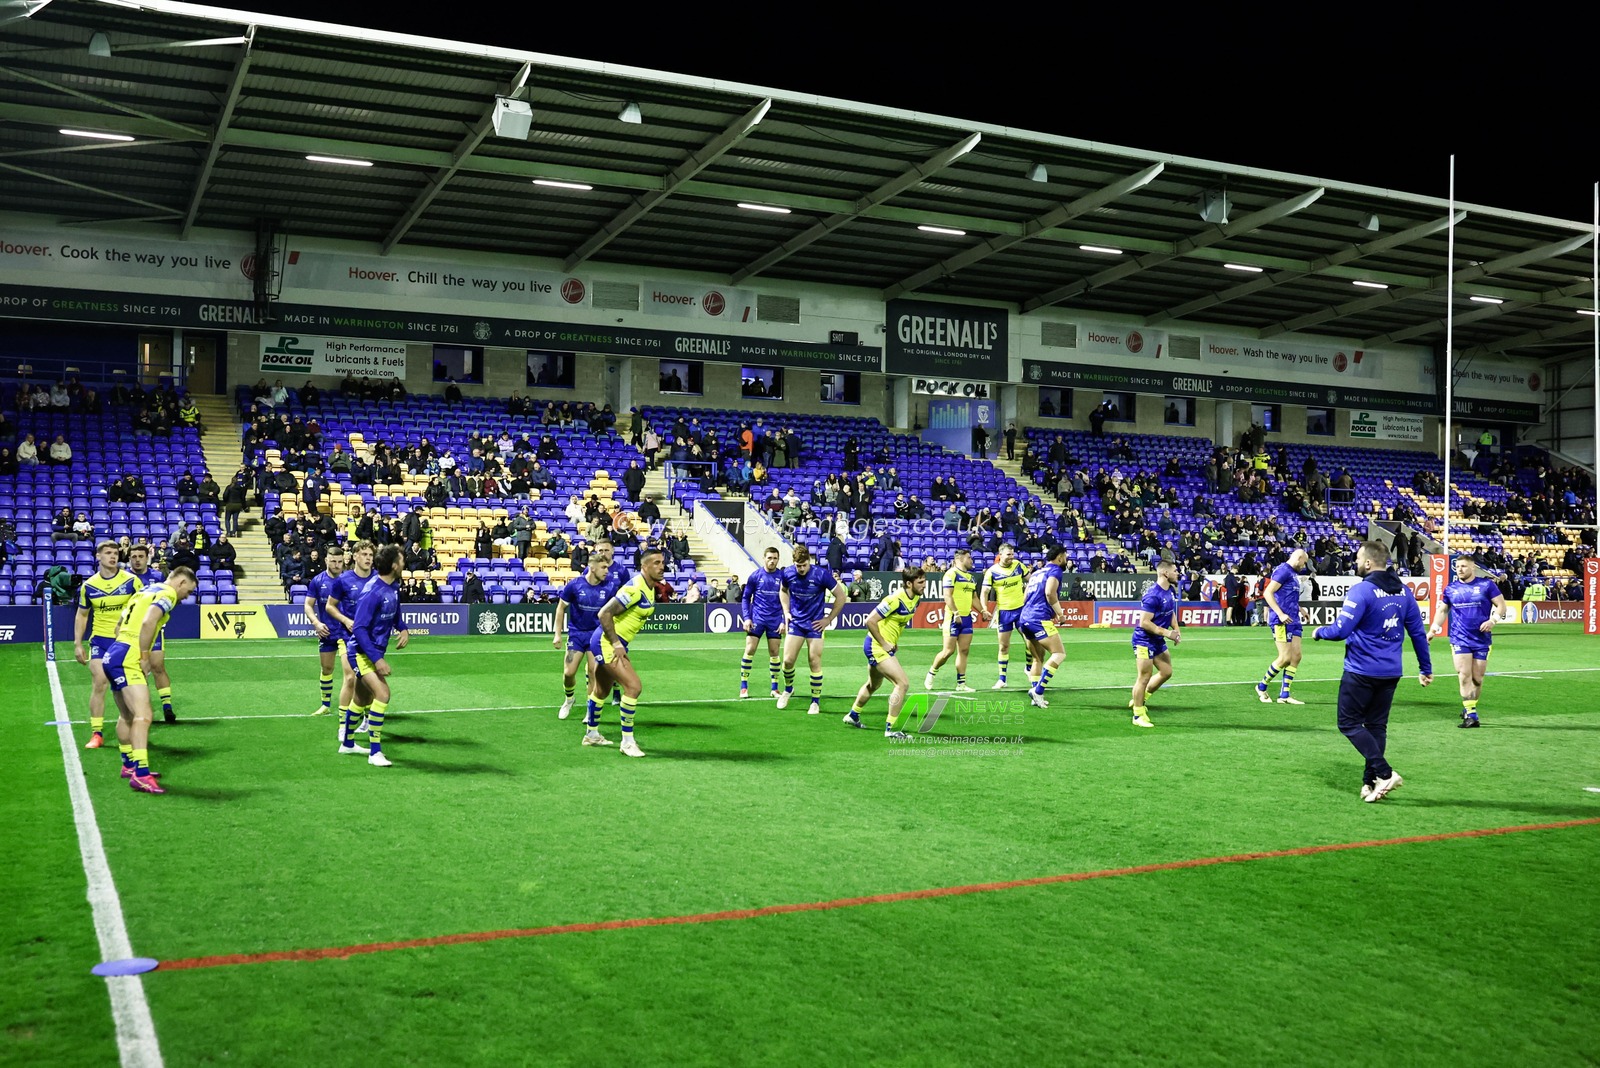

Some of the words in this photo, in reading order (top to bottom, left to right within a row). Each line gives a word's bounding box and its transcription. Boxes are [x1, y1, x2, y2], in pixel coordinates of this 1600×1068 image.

[60, 245, 99, 260] Cook
[105, 249, 131, 262] the
[135, 253, 165, 267] way
[171, 256, 198, 268] you
[205, 255, 231, 269] live
[349, 267, 399, 282] Hoover.
[407, 271, 437, 285] Chill
[443, 274, 465, 286] the
[472, 278, 497, 291] way
[502, 281, 525, 292] you
[530, 281, 552, 293] live
[653, 291, 696, 306] Hoover.
[32, 298, 49, 307] OF
[52, 300, 119, 311] GREATNESS
[123, 304, 156, 314] SINCE
[160, 307, 181, 315] 1761
[284, 314, 315, 323] MADE
[319, 317, 330, 325] IN
[333, 318, 404, 329] WARRINGTON
[407, 322, 437, 332] SINCE
[440, 325, 459, 333] 1761
[515, 329, 541, 338] DROP
[560, 333, 612, 343] GREATNESS
[615, 336, 642, 345] SINCE
[644, 339, 661, 347] 1761
[898, 315, 998, 350] GREENALL'S
[1088, 332, 1121, 345] Hoover.
[326, 341, 347, 352] High
[349, 344, 405, 354] Performance
[675, 337, 731, 355] GREENALL'S
[916, 349, 942, 357] ORIGINAL
[262, 355, 294, 364] ROCK
[295, 356, 313, 365] OIL
[325, 353, 371, 365] Lubricants
[373, 357, 379, 365] &
[382, 358, 405, 367] Fuels
[741, 346, 766, 355] MADE
[768, 348, 778, 356] IN
[780, 349, 836, 360] WARRINGTON
[838, 353, 862, 362] SINCE
[864, 355, 879, 363] 1761
[1209, 344, 1239, 356] Hoover.
[1243, 347, 1264, 358] Wash
[1266, 350, 1279, 360] the
[1281, 352, 1297, 363] way
[1299, 354, 1313, 364] you
[1315, 354, 1328, 364] live
[335, 368, 395, 377] www.rockoil.com
[1051, 371, 1071, 379] MADE
[1083, 373, 1129, 383] WARRINGTON
[1130, 377, 1149, 385] SINCE
[1151, 378, 1164, 386] 1761
[1471, 370, 1482, 379] the
[1484, 372, 1497, 382] way
[1498, 374, 1511, 383] you
[1512, 374, 1524, 383] live
[916, 379, 959, 395] ROCK
[1172, 377, 1213, 392] GREENALL'S
[1226, 385, 1243, 393] DROP
[1255, 388, 1288, 397] GREATNESS
[1289, 390, 1306, 398] SINCE
[1369, 397, 1405, 405] WARRINGTON
[1383, 423, 1405, 432] Lubricants
[1589, 577, 1597, 632] BETFRED
[402, 612, 437, 624] IFTING
[441, 612, 460, 624] LTD
[1539, 609, 1566, 619] UNCLE
[288, 629, 307, 637] PROUD
